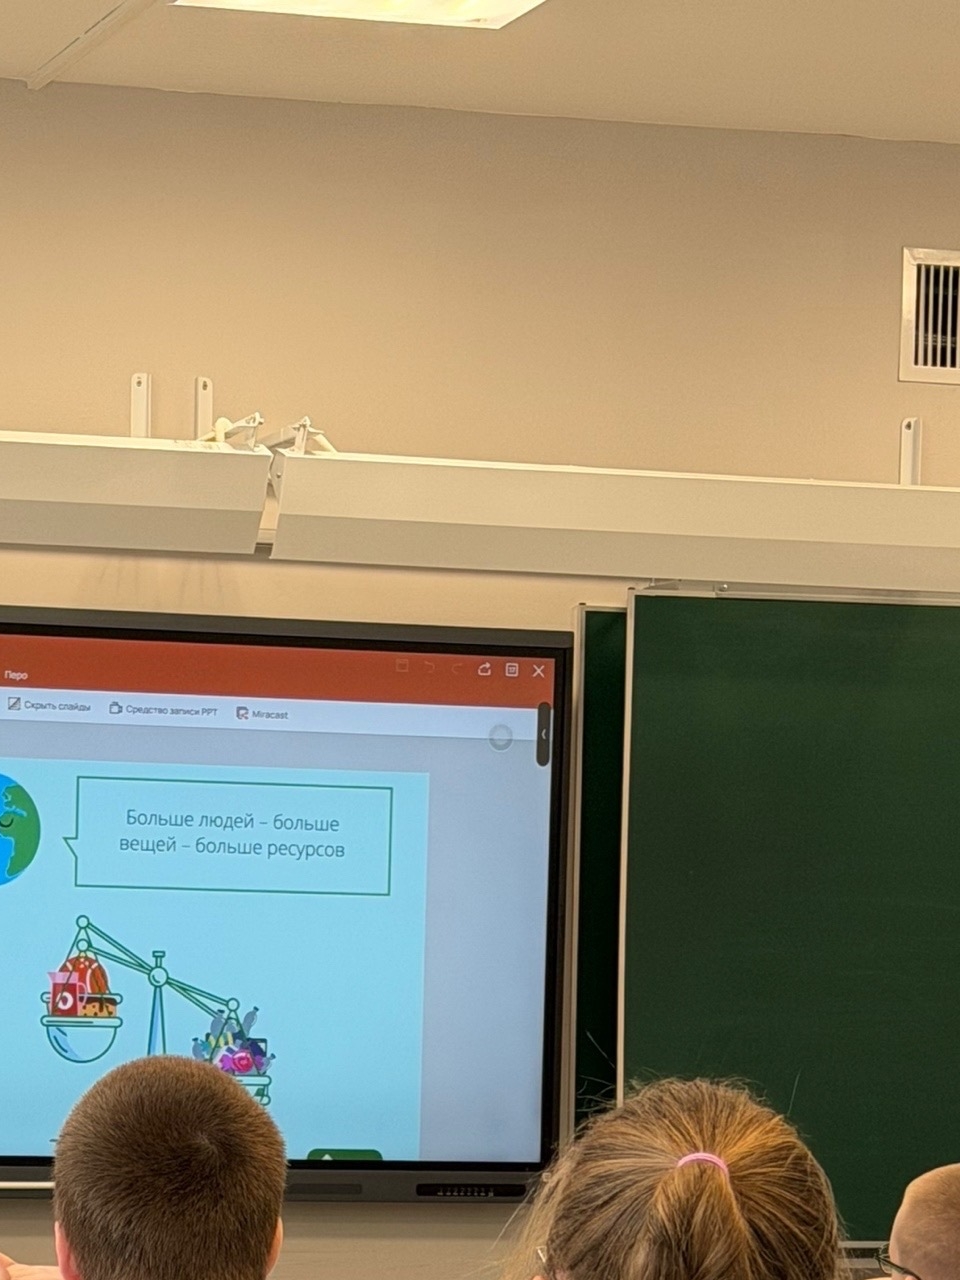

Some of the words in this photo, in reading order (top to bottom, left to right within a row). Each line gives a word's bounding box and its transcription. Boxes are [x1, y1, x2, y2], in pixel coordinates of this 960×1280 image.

[4, 670, 28, 681] Перо
[24, 700, 57, 711] Скрыть
[58, 702, 92, 713] слайды
[125, 704, 169, 716] Средство
[169, 707, 200, 717] записи
[252, 710, 289, 720] Miracast
[126, 808, 194, 828] Больше
[198, 812, 255, 831] людей
[273, 814, 340, 832] больше
[119, 836, 176, 854] вещей
[195, 837, 263, 855] больше
[267, 842, 345, 861] ресурсов
